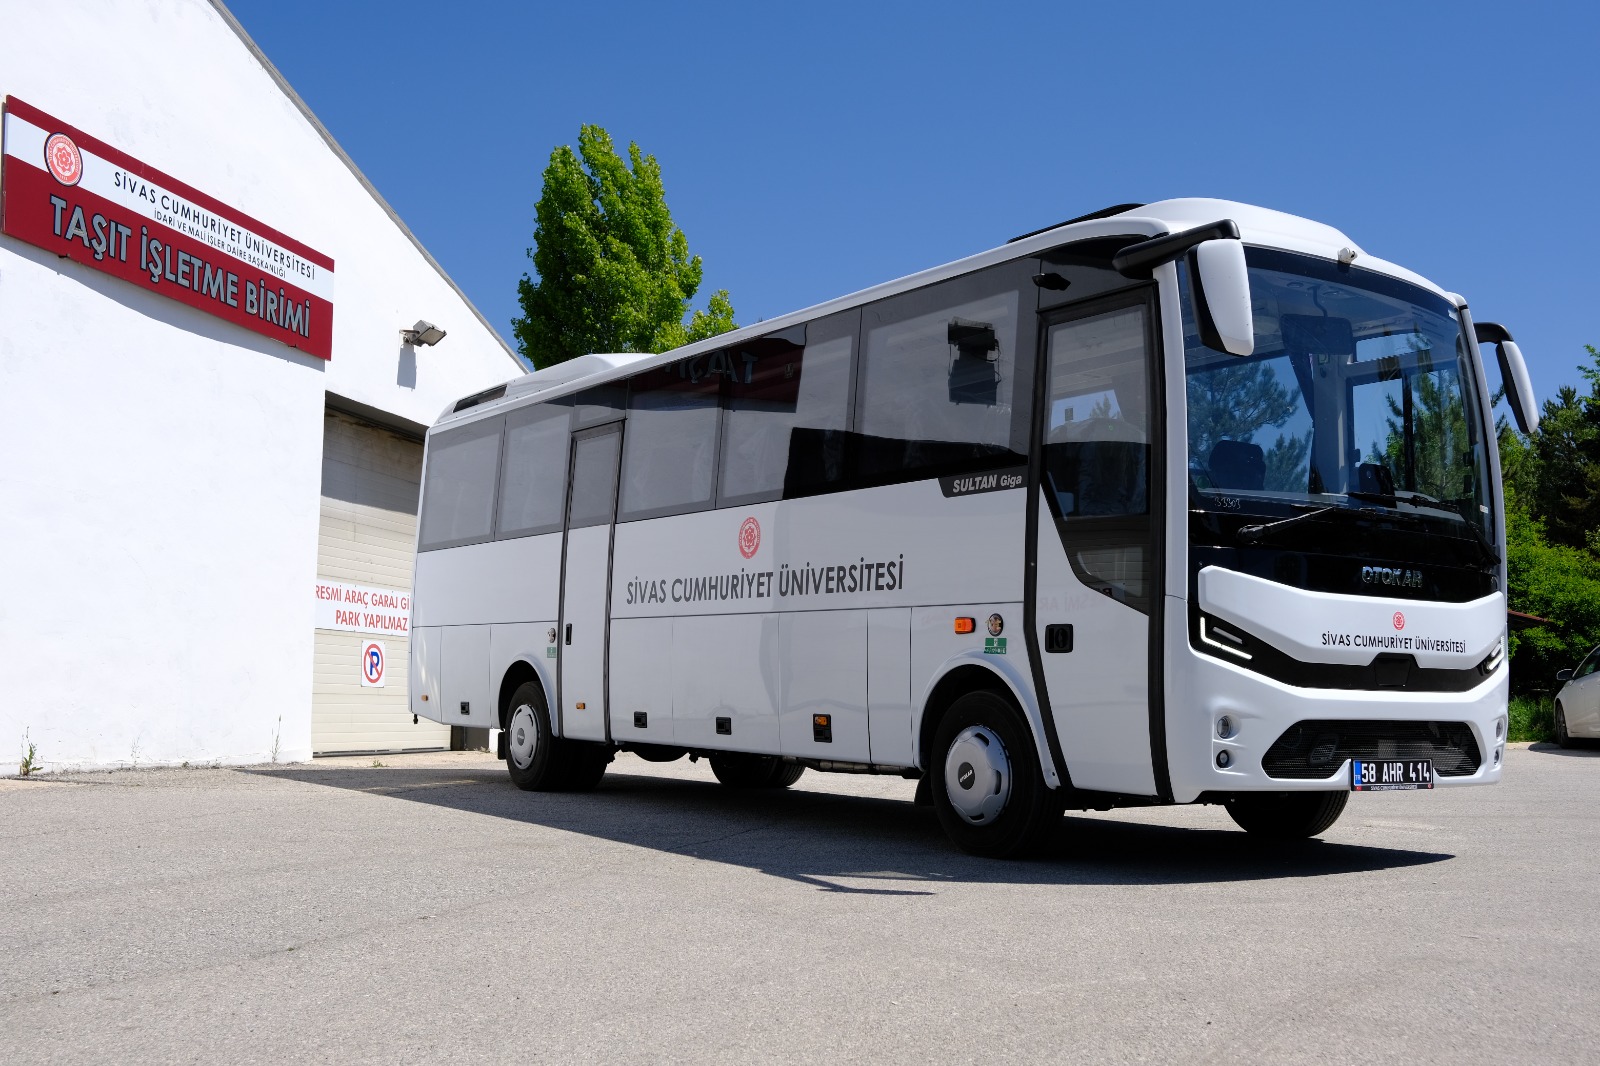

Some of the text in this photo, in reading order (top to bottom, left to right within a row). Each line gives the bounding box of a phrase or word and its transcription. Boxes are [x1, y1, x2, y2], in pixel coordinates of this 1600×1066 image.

[114, 171, 316, 281] SİVAS CUMHURİYET ÜNİVERSİTESİ
[154, 207, 287, 279] İDARİ VE MALİ İŞLER DAİRE BAŞKANLIĞI
[50, 194, 311, 339] TAŞIT İŞLETME BİRİMİ
[952, 474, 1023, 493] SULTAN Giga
[626, 553, 904, 605] SİVAS CUMHURİYET ÜNİVERSİTESİ
[1361, 566, 1423, 588] OTOKAR
[316, 585, 342, 602] RESMİ
[344, 590, 369, 609] ARAÇ
[371, 593, 398, 609] GARAJ
[335, 610, 408, 631] PARK YAPILMAZ
[1321, 631, 1466, 653] SİVAS CUMHURİYET ÜNİVERSİTESİ
[1361, 762, 1430, 782] 58 AHR 414
